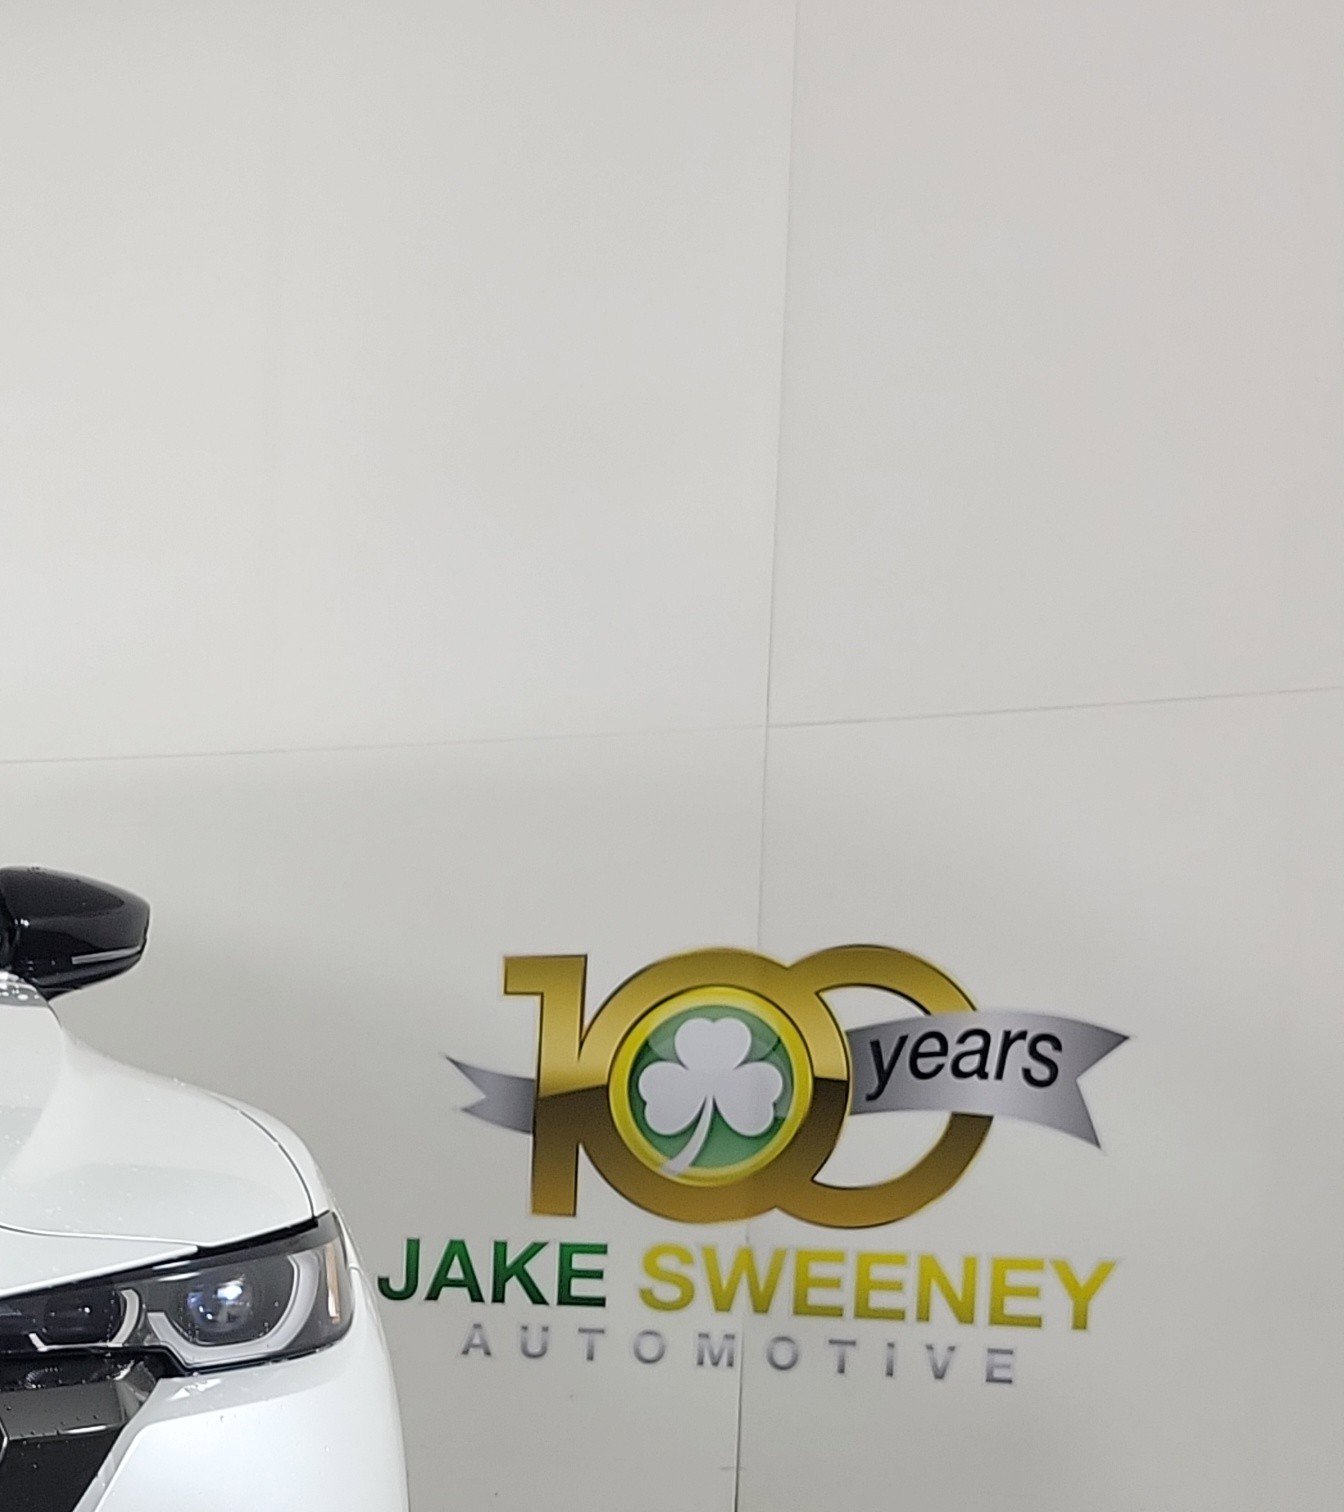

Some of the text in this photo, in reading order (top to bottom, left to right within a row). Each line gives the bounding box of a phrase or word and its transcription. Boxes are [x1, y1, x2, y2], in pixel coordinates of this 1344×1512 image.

[503, 943, 1064, 1229] 100 years
[377, 1237, 1117, 1331] JAKE SWEENEY
[461, 1322, 1015, 1384] AUTOMOTIVE
